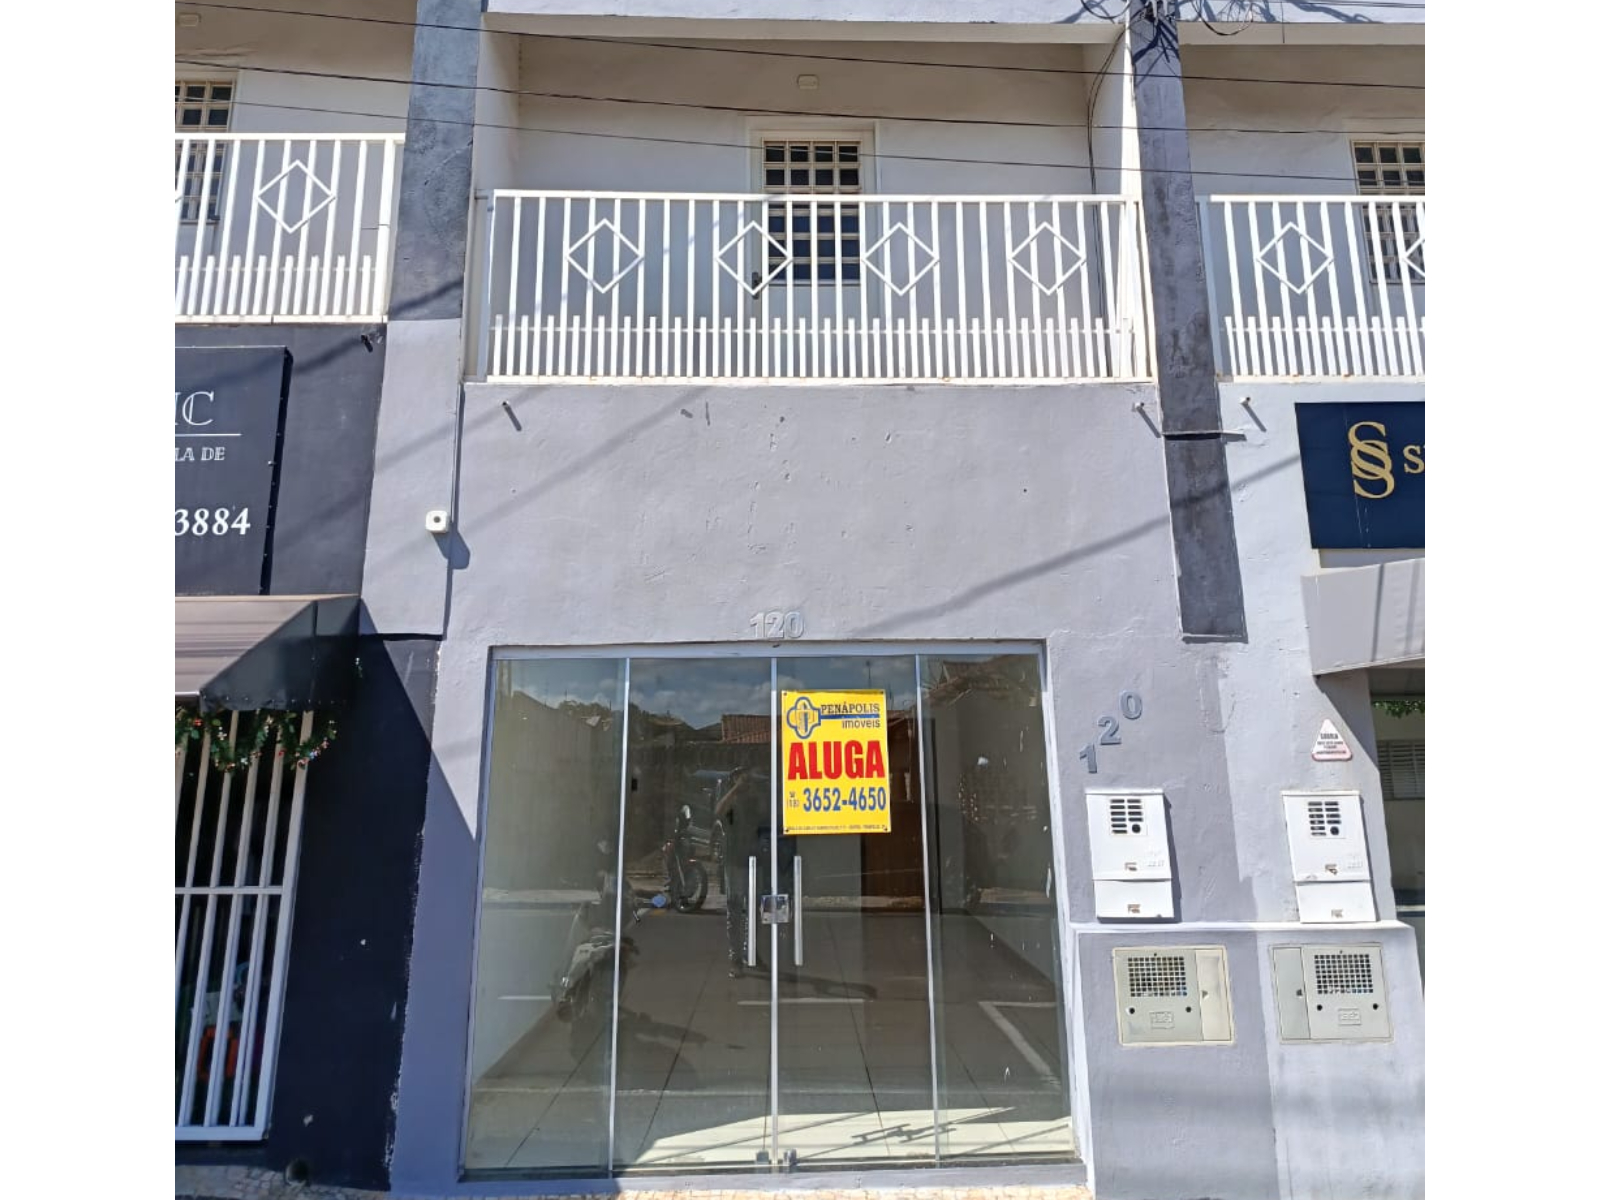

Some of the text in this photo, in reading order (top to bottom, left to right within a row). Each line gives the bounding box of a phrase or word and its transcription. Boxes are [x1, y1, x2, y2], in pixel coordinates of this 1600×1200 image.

[201, 446, 225, 461] DE
[1403, 444, 1425, 474] S
[175, 507, 251, 537] 3884
[750, 611, 804, 638] 120
[821, 701, 880, 715] PENÁPOLIS
[787, 740, 885, 780] ALUGA
[803, 786, 886, 812] 3652-4650
